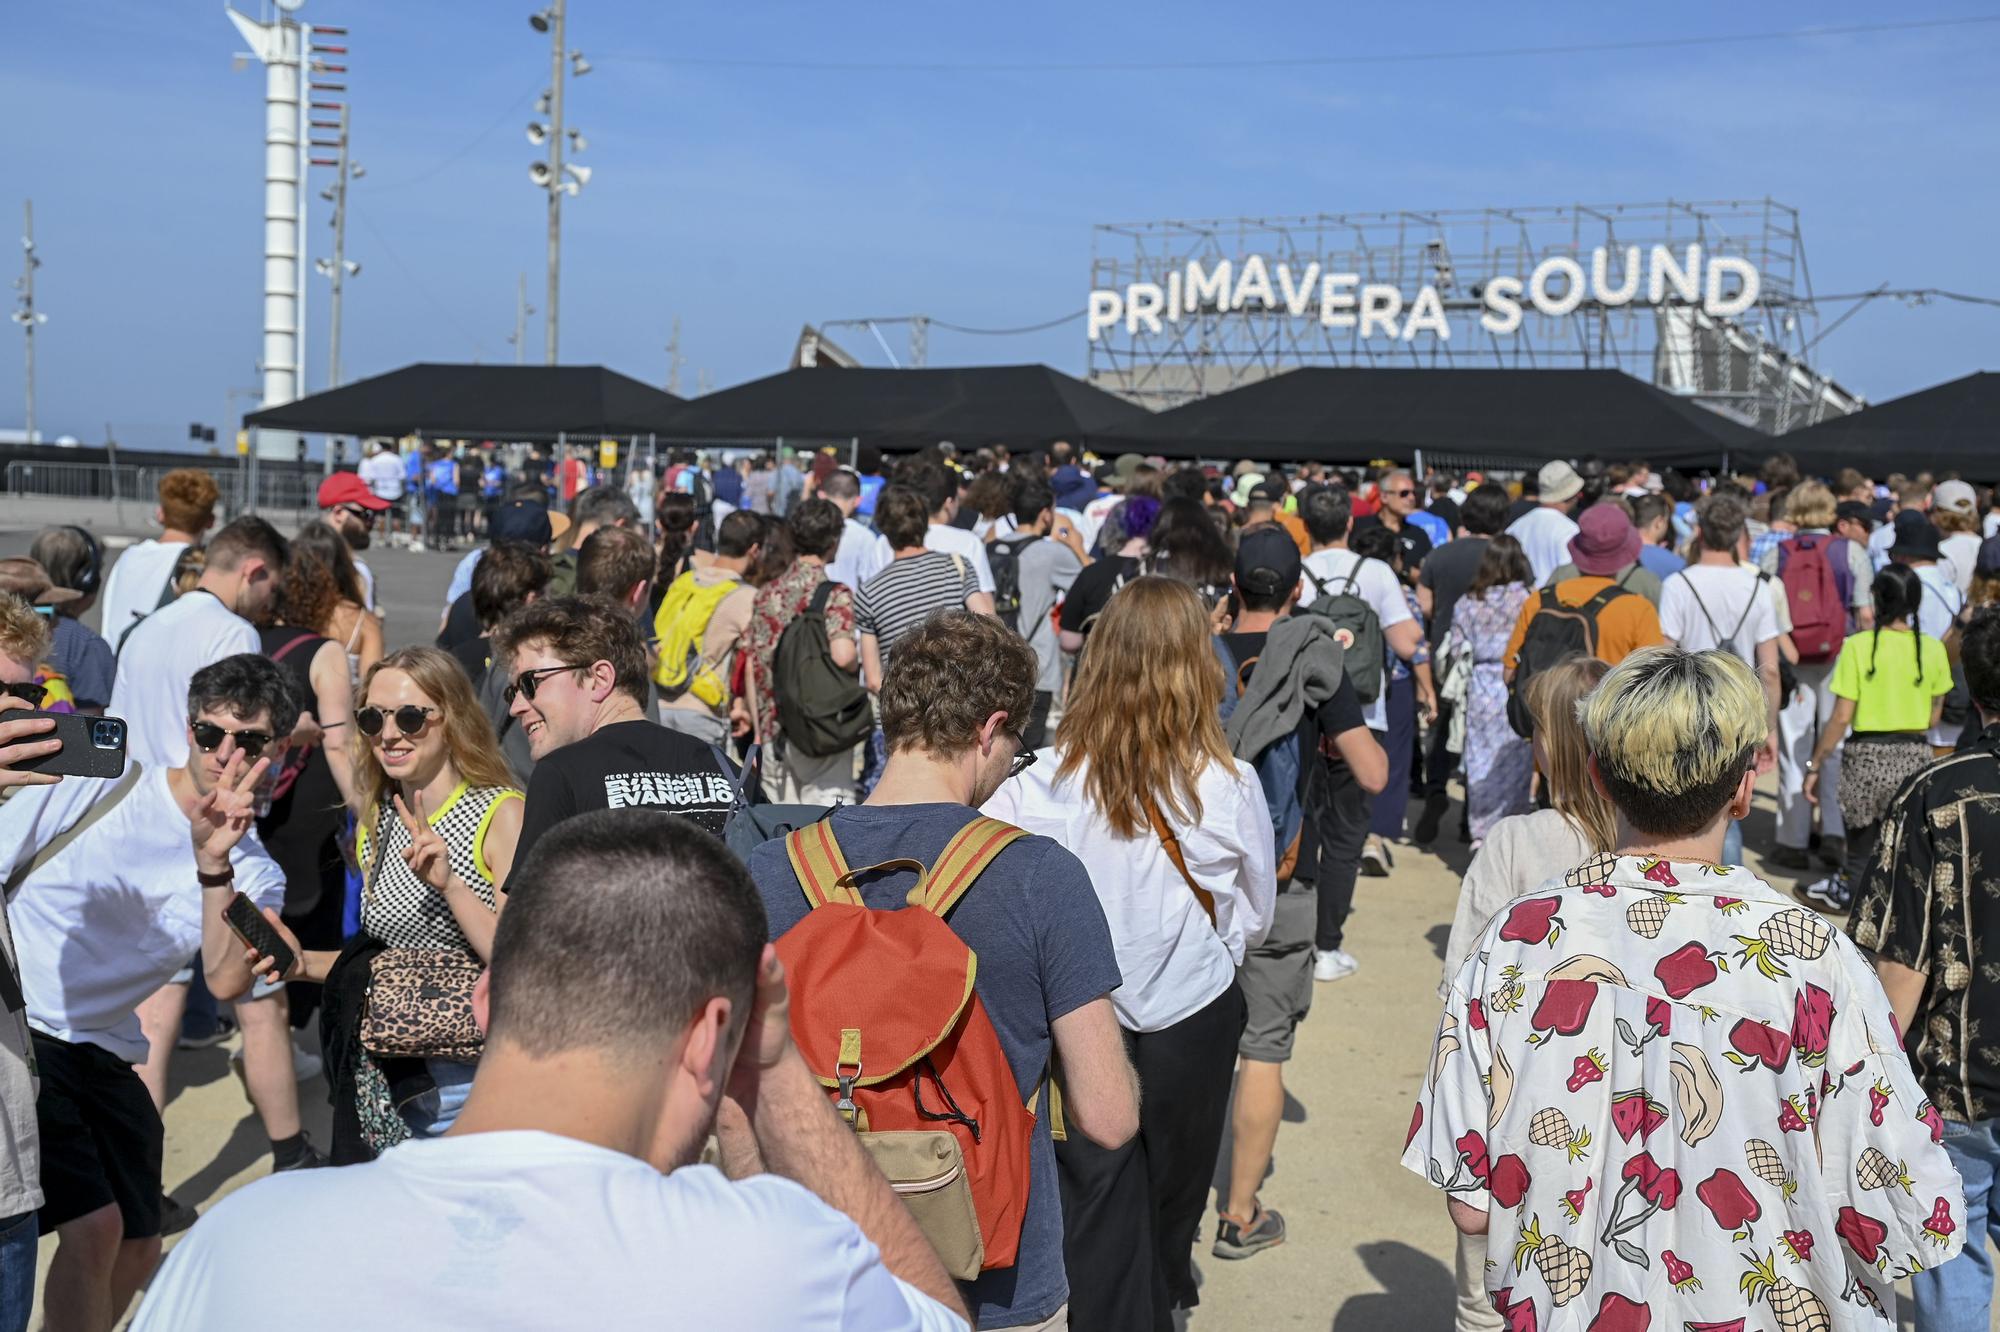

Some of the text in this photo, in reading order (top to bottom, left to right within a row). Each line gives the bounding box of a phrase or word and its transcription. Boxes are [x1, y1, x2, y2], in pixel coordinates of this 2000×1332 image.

[1087, 243, 1761, 341] PRIMAVERA SOUND
[605, 778, 735, 809] EVANGELIO
